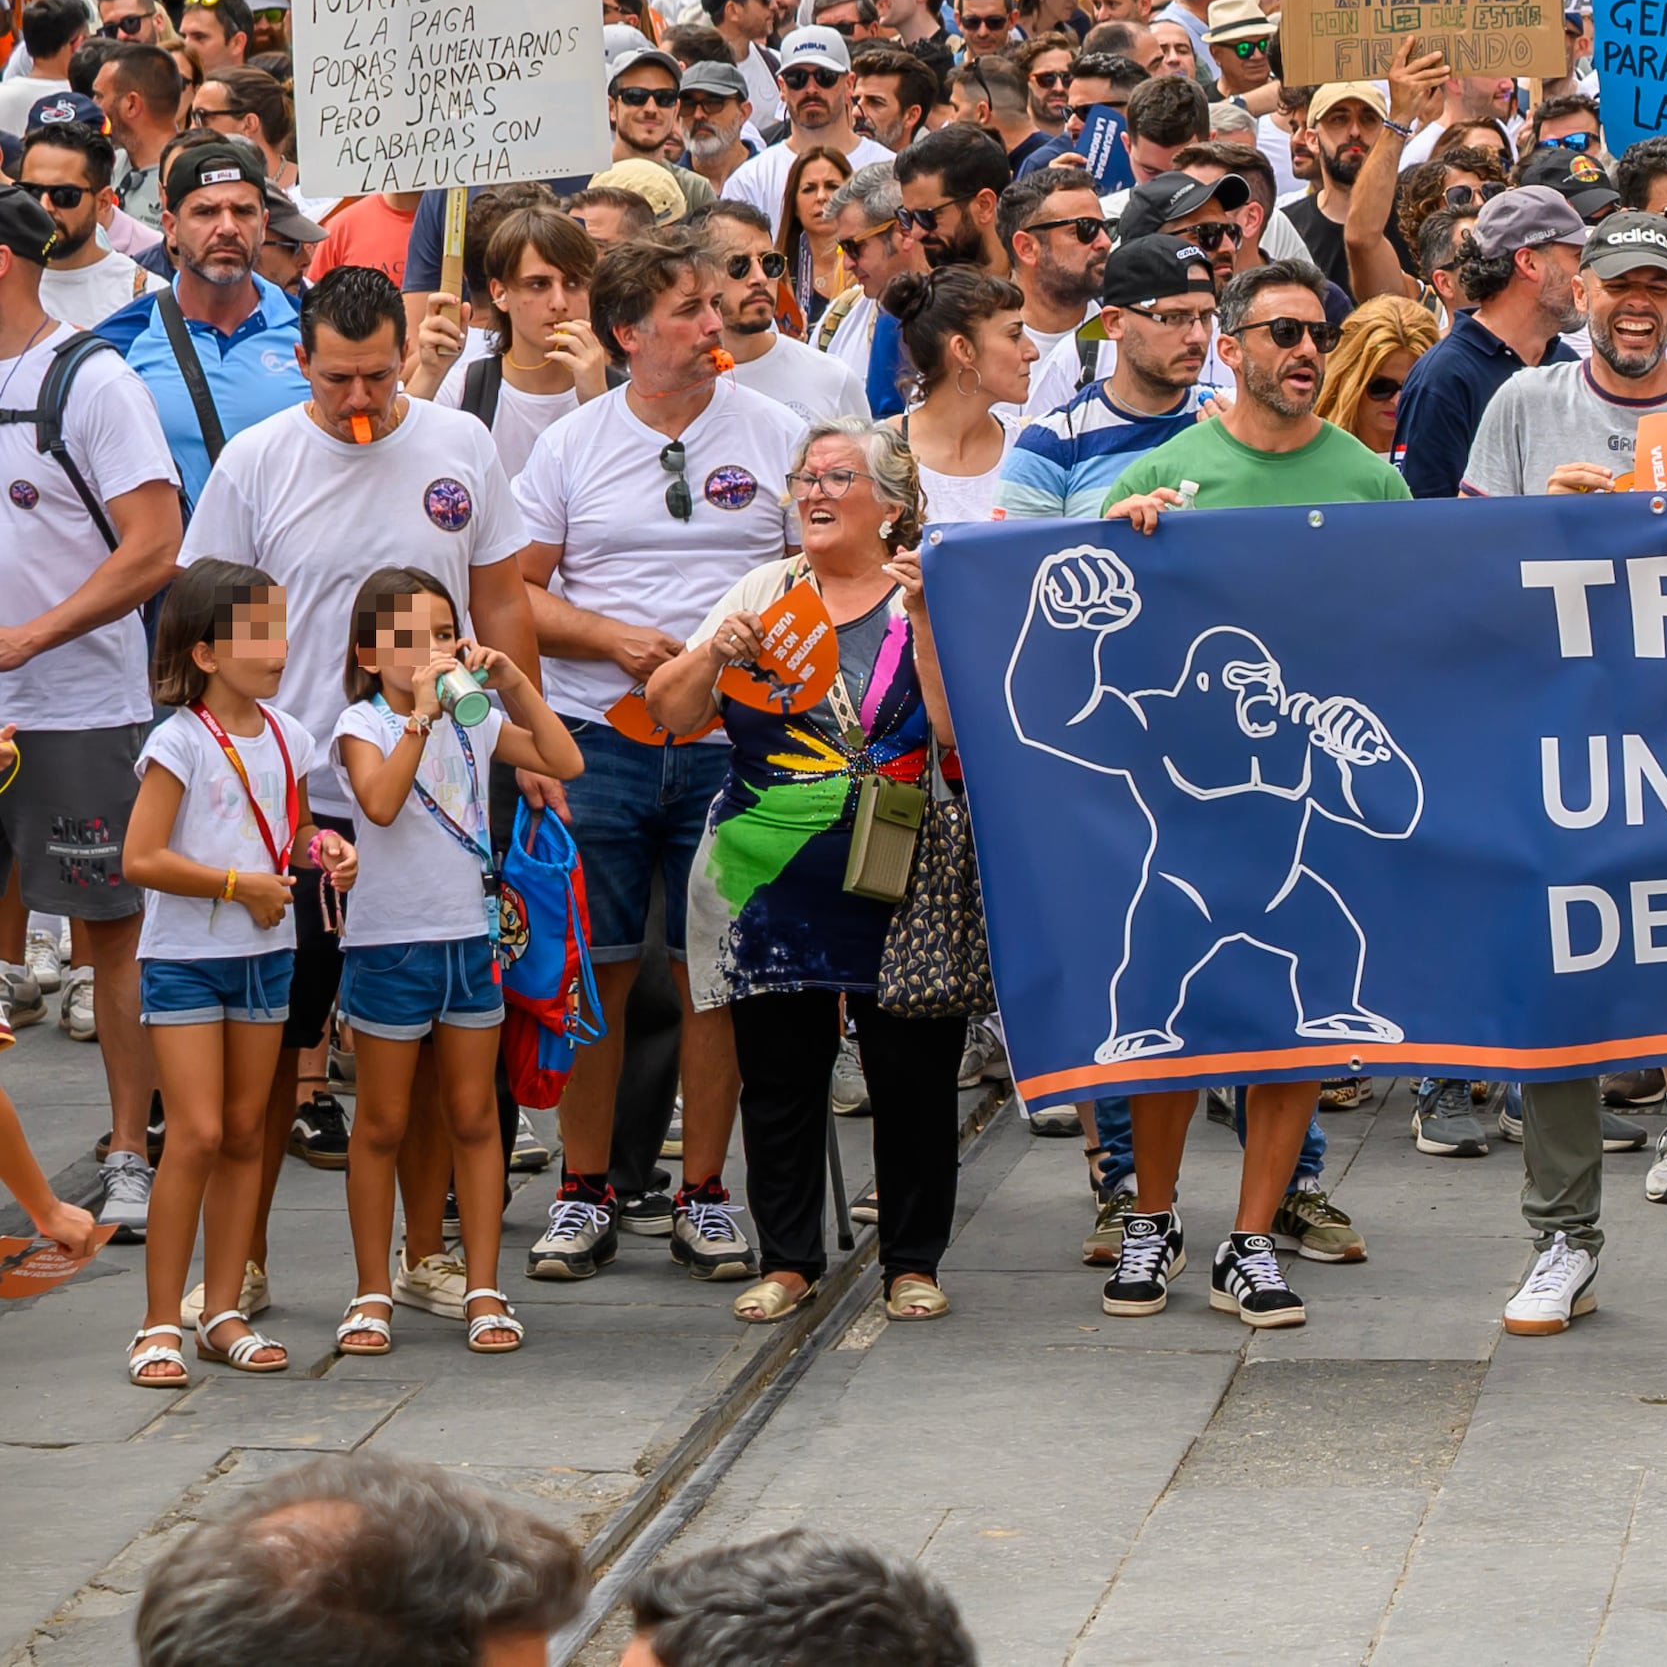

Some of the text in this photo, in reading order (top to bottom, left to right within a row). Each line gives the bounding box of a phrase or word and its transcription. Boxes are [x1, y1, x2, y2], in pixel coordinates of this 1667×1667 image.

[344, 5, 476, 51] LA PAGA
[1311, 9, 1359, 36] CON
[310, 26, 580, 95] PODRAS AUMENTARNOS
[793, 42, 827, 53] AIRBUS
[348, 60, 544, 103] LAS JORNADAS
[320, 86, 498, 137] PERO JAMAS
[1096, 116, 1107, 134] LA
[337, 116, 542, 167] ACABARAS CON
[1095, 119, 1118, 180] RECUPERAR
[361, 147, 513, 193] LA LUCHA
[1523, 228, 1556, 244] AIRBUS
[773, 631, 800, 662] NO SE
[786, 620, 829, 672] NOSOTROS
[798, 662, 816, 683] SIN
